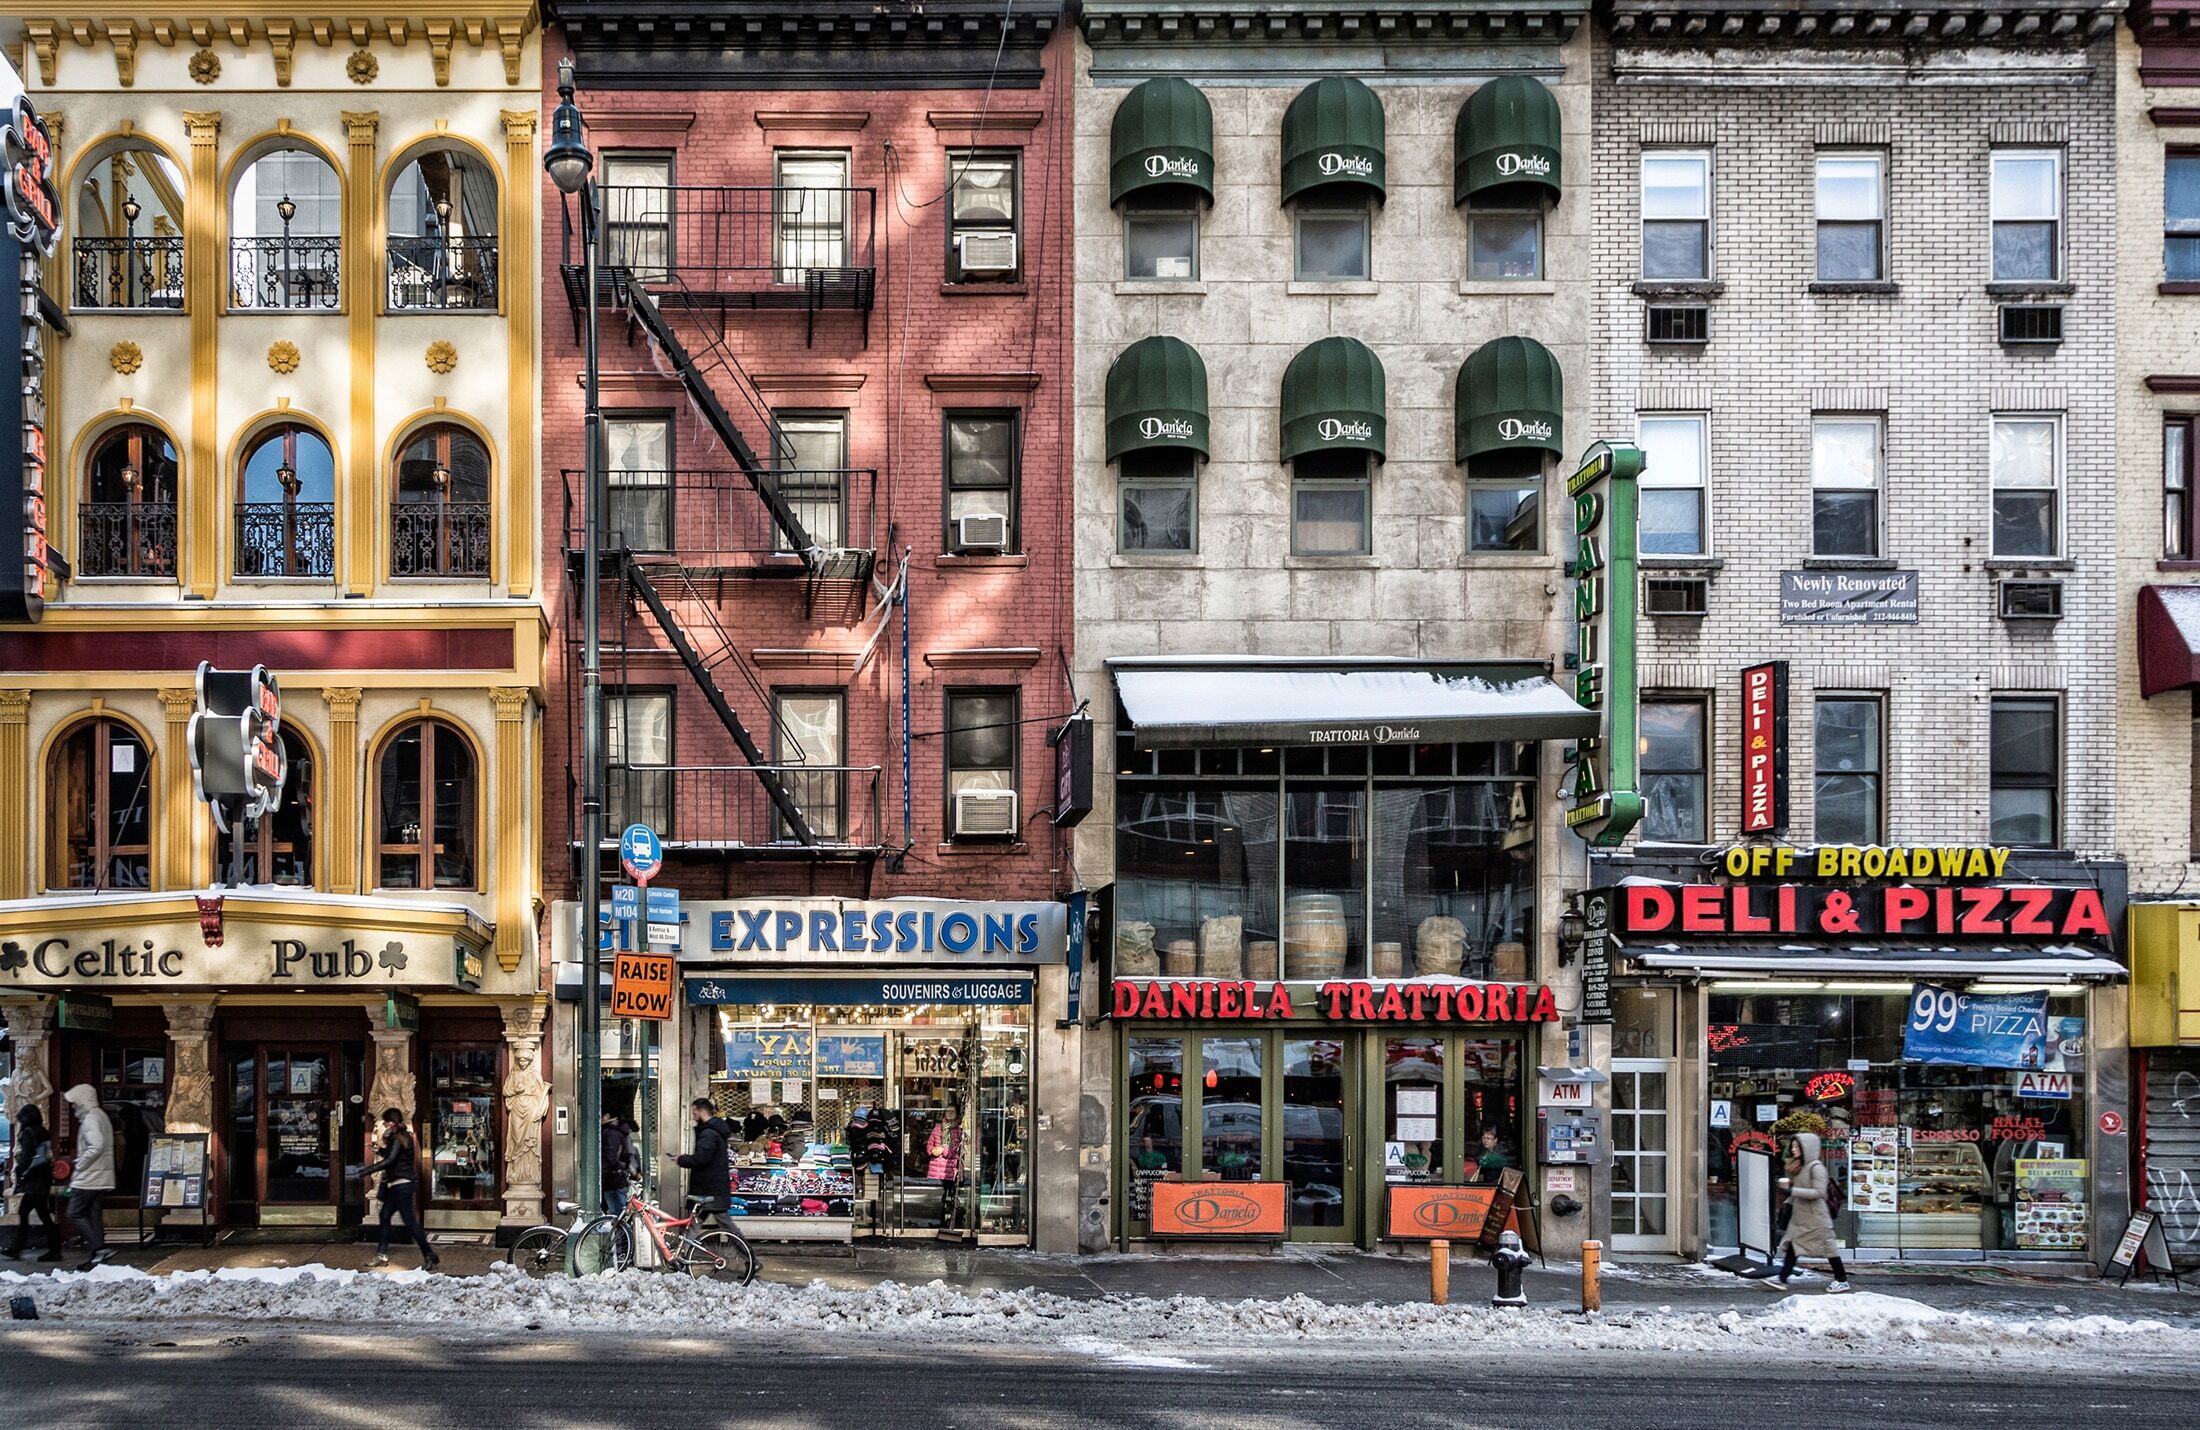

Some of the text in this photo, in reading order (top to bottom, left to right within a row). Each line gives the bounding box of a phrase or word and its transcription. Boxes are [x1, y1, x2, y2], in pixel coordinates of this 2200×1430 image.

[22, 113, 50, 167] BAR
[1144, 154, 1199, 178] Daniela
[1318, 153, 1373, 177] Daniela
[1495, 153, 1551, 176] Daniela
[1139, 417, 1194, 440] Daniela
[1317, 418, 1372, 441] Daniela
[1497, 418, 1553, 441] Daniela
[1567, 461, 1602, 494] TRATTORIA
[1792, 575, 1907, 595] Newly Renovated
[1782, 599, 1917, 610] Two Bed Room Apartment Rental
[1782, 612, 1816, 621] Furnished
[1825, 612, 1867, 621] Unfurnished
[1574, 492, 1602, 798] DANIEA
[1752, 671, 1768, 730] DELI
[1309, 725, 1420, 744] TRATTORIA Daniela
[1751, 735, 1768, 750] &
[1751, 754, 1768, 827] PIZZA
[1567, 799, 1602, 826] TRATTORIA
[1726, 847, 2011, 877] OFF BROADWAY
[615, 888, 634, 901] M20
[615, 905, 638, 918] M104
[1627, 885, 2111, 935] DELI & PIZZA
[710, 909, 1040, 954] EXPRESSIONS
[33, 938, 373, 978] Celtic Pub
[620, 961, 668, 982] RAISE
[617, 991, 668, 1012] PLOW
[882, 983, 1022, 1000] SOUVENIRS & LUGGAGE
[1113, 981, 1559, 1022] DANIELA TRATTORIA
[1972, 1004, 2043, 1014] Freshly Baked Cheese
[1971, 1014, 2042, 1037] PIZZA
[147, 1062, 159, 1077] A
[295, 1073, 307, 1087] A
[1552, 1084, 1580, 1099] ATM
[1804, 1073, 1855, 1097] HOT PIZZA
[2020, 1073, 2069, 1091] ATM
[1714, 1104, 1727, 1119] A
[1992, 1117, 2044, 1128] HALAL
[1912, 1129, 1980, 1142] ESPRESSO
[1991, 1128, 2046, 1140] FOODS
[1389, 1145, 1401, 1160] A
[1191, 1189, 1245, 1198] TRATTORIA
[1430, 1192, 1484, 1202] TRATTORIA
[1181, 1198, 1256, 1222] Daniela
[1420, 1201, 1485, 1225] Daniel
